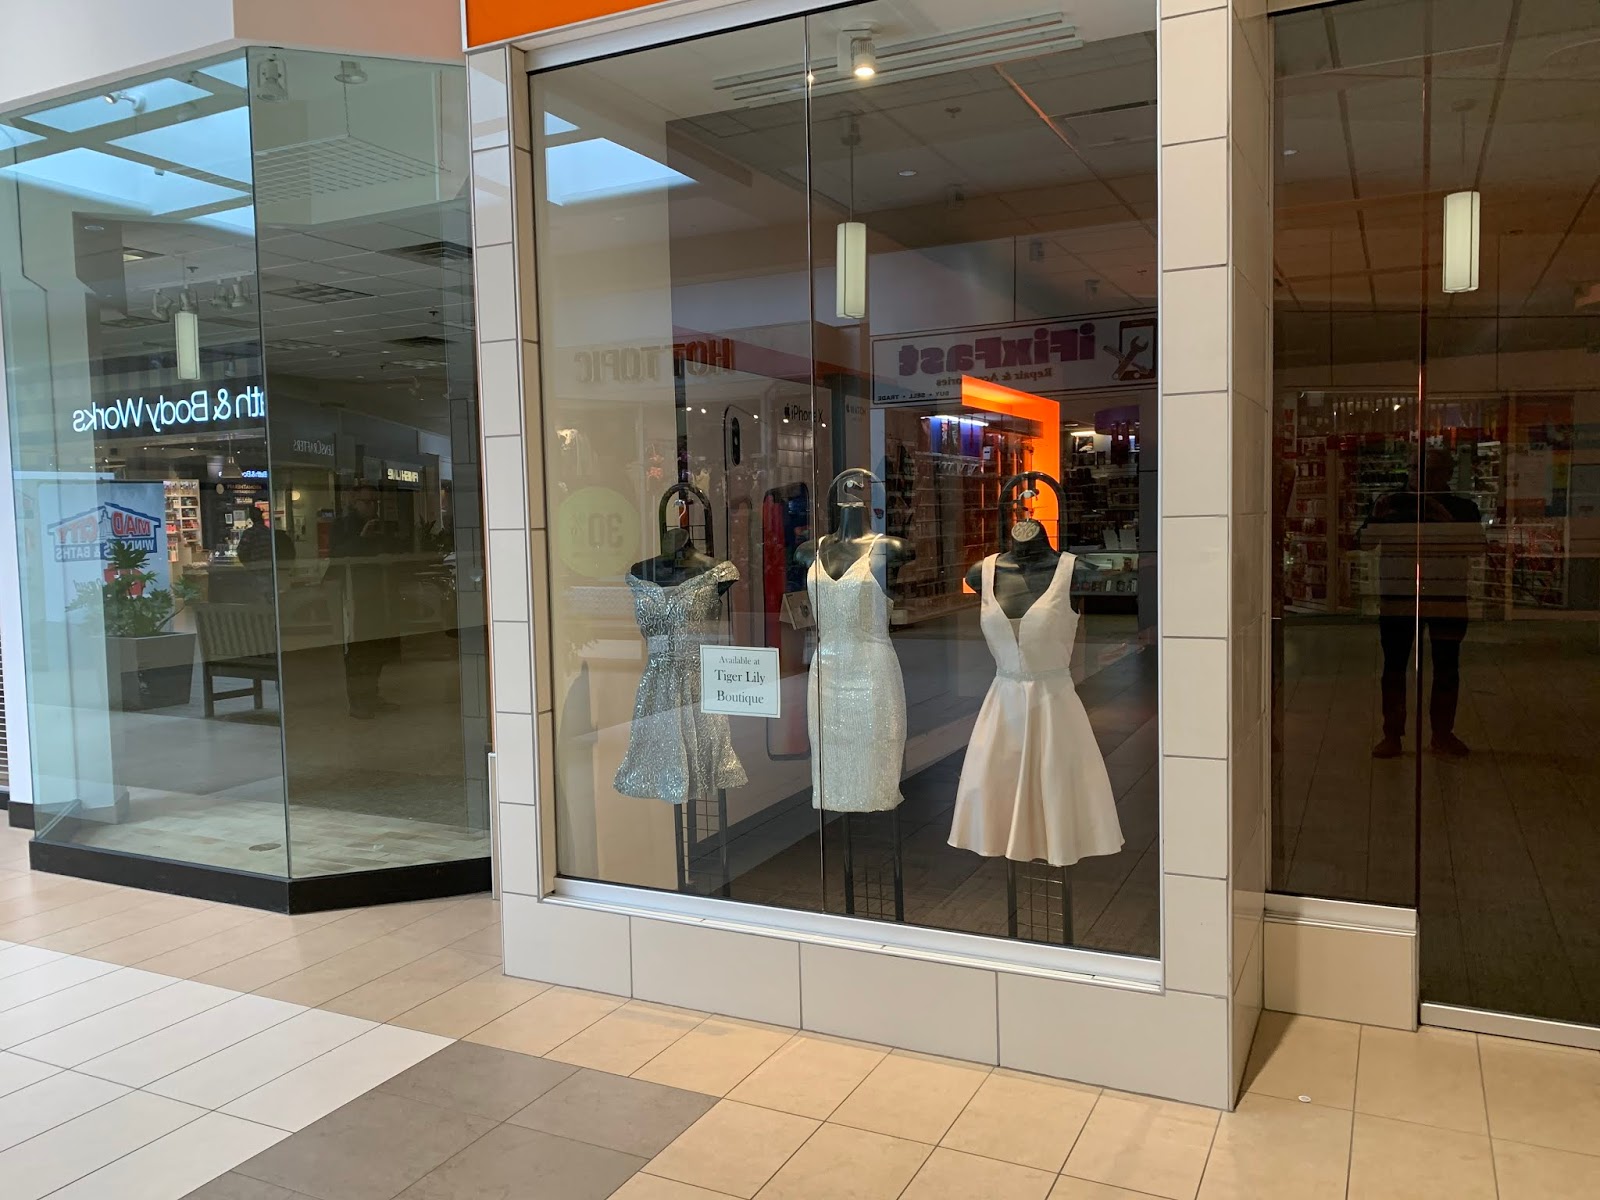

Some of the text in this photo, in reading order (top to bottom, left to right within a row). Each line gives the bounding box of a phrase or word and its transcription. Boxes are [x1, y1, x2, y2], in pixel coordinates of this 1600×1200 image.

[719, 656, 751, 665] Available
[714, 670, 766, 685] Tiger Lily
[717, 690, 764, 706] Boutique
